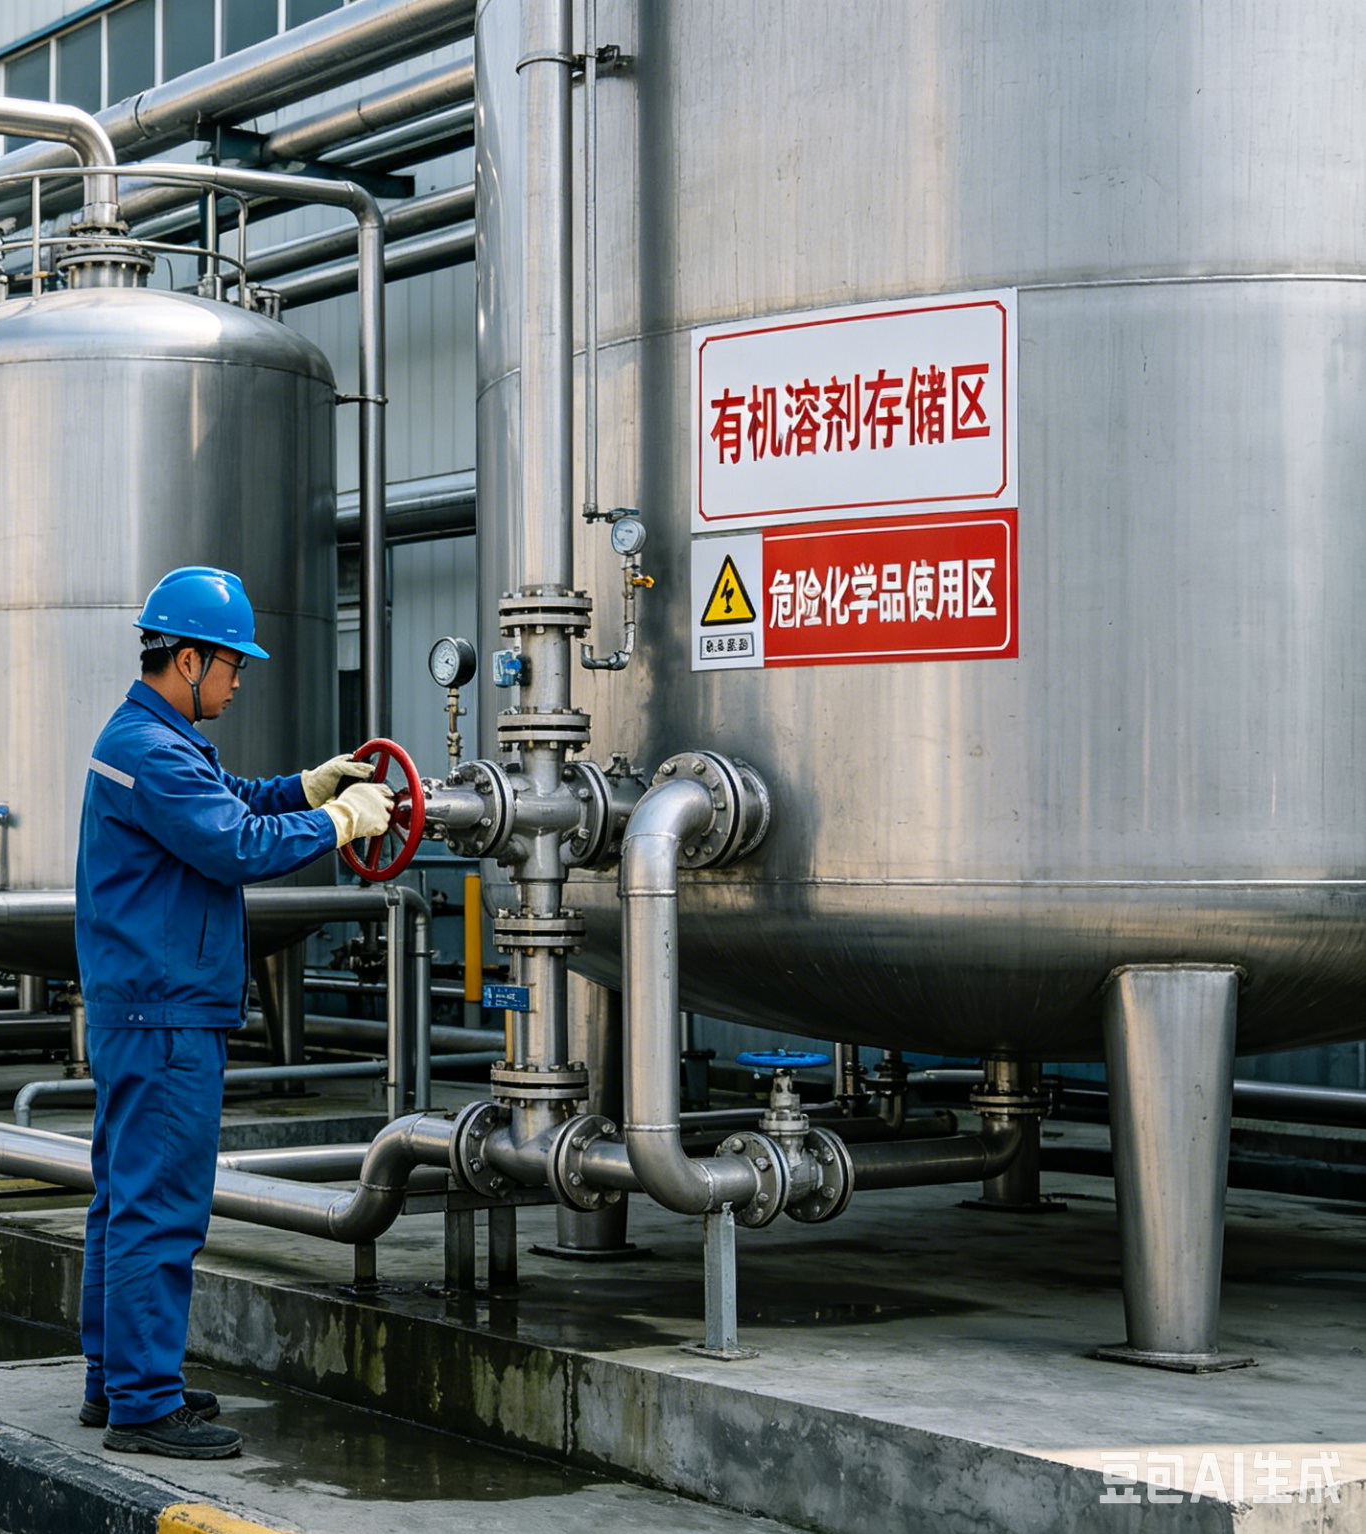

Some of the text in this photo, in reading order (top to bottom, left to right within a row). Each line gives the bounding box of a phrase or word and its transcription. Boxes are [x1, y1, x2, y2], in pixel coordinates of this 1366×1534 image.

[710, 363, 991, 464] 有机溶剂存储区
[768, 558, 997, 628] 危险化学品使用区
